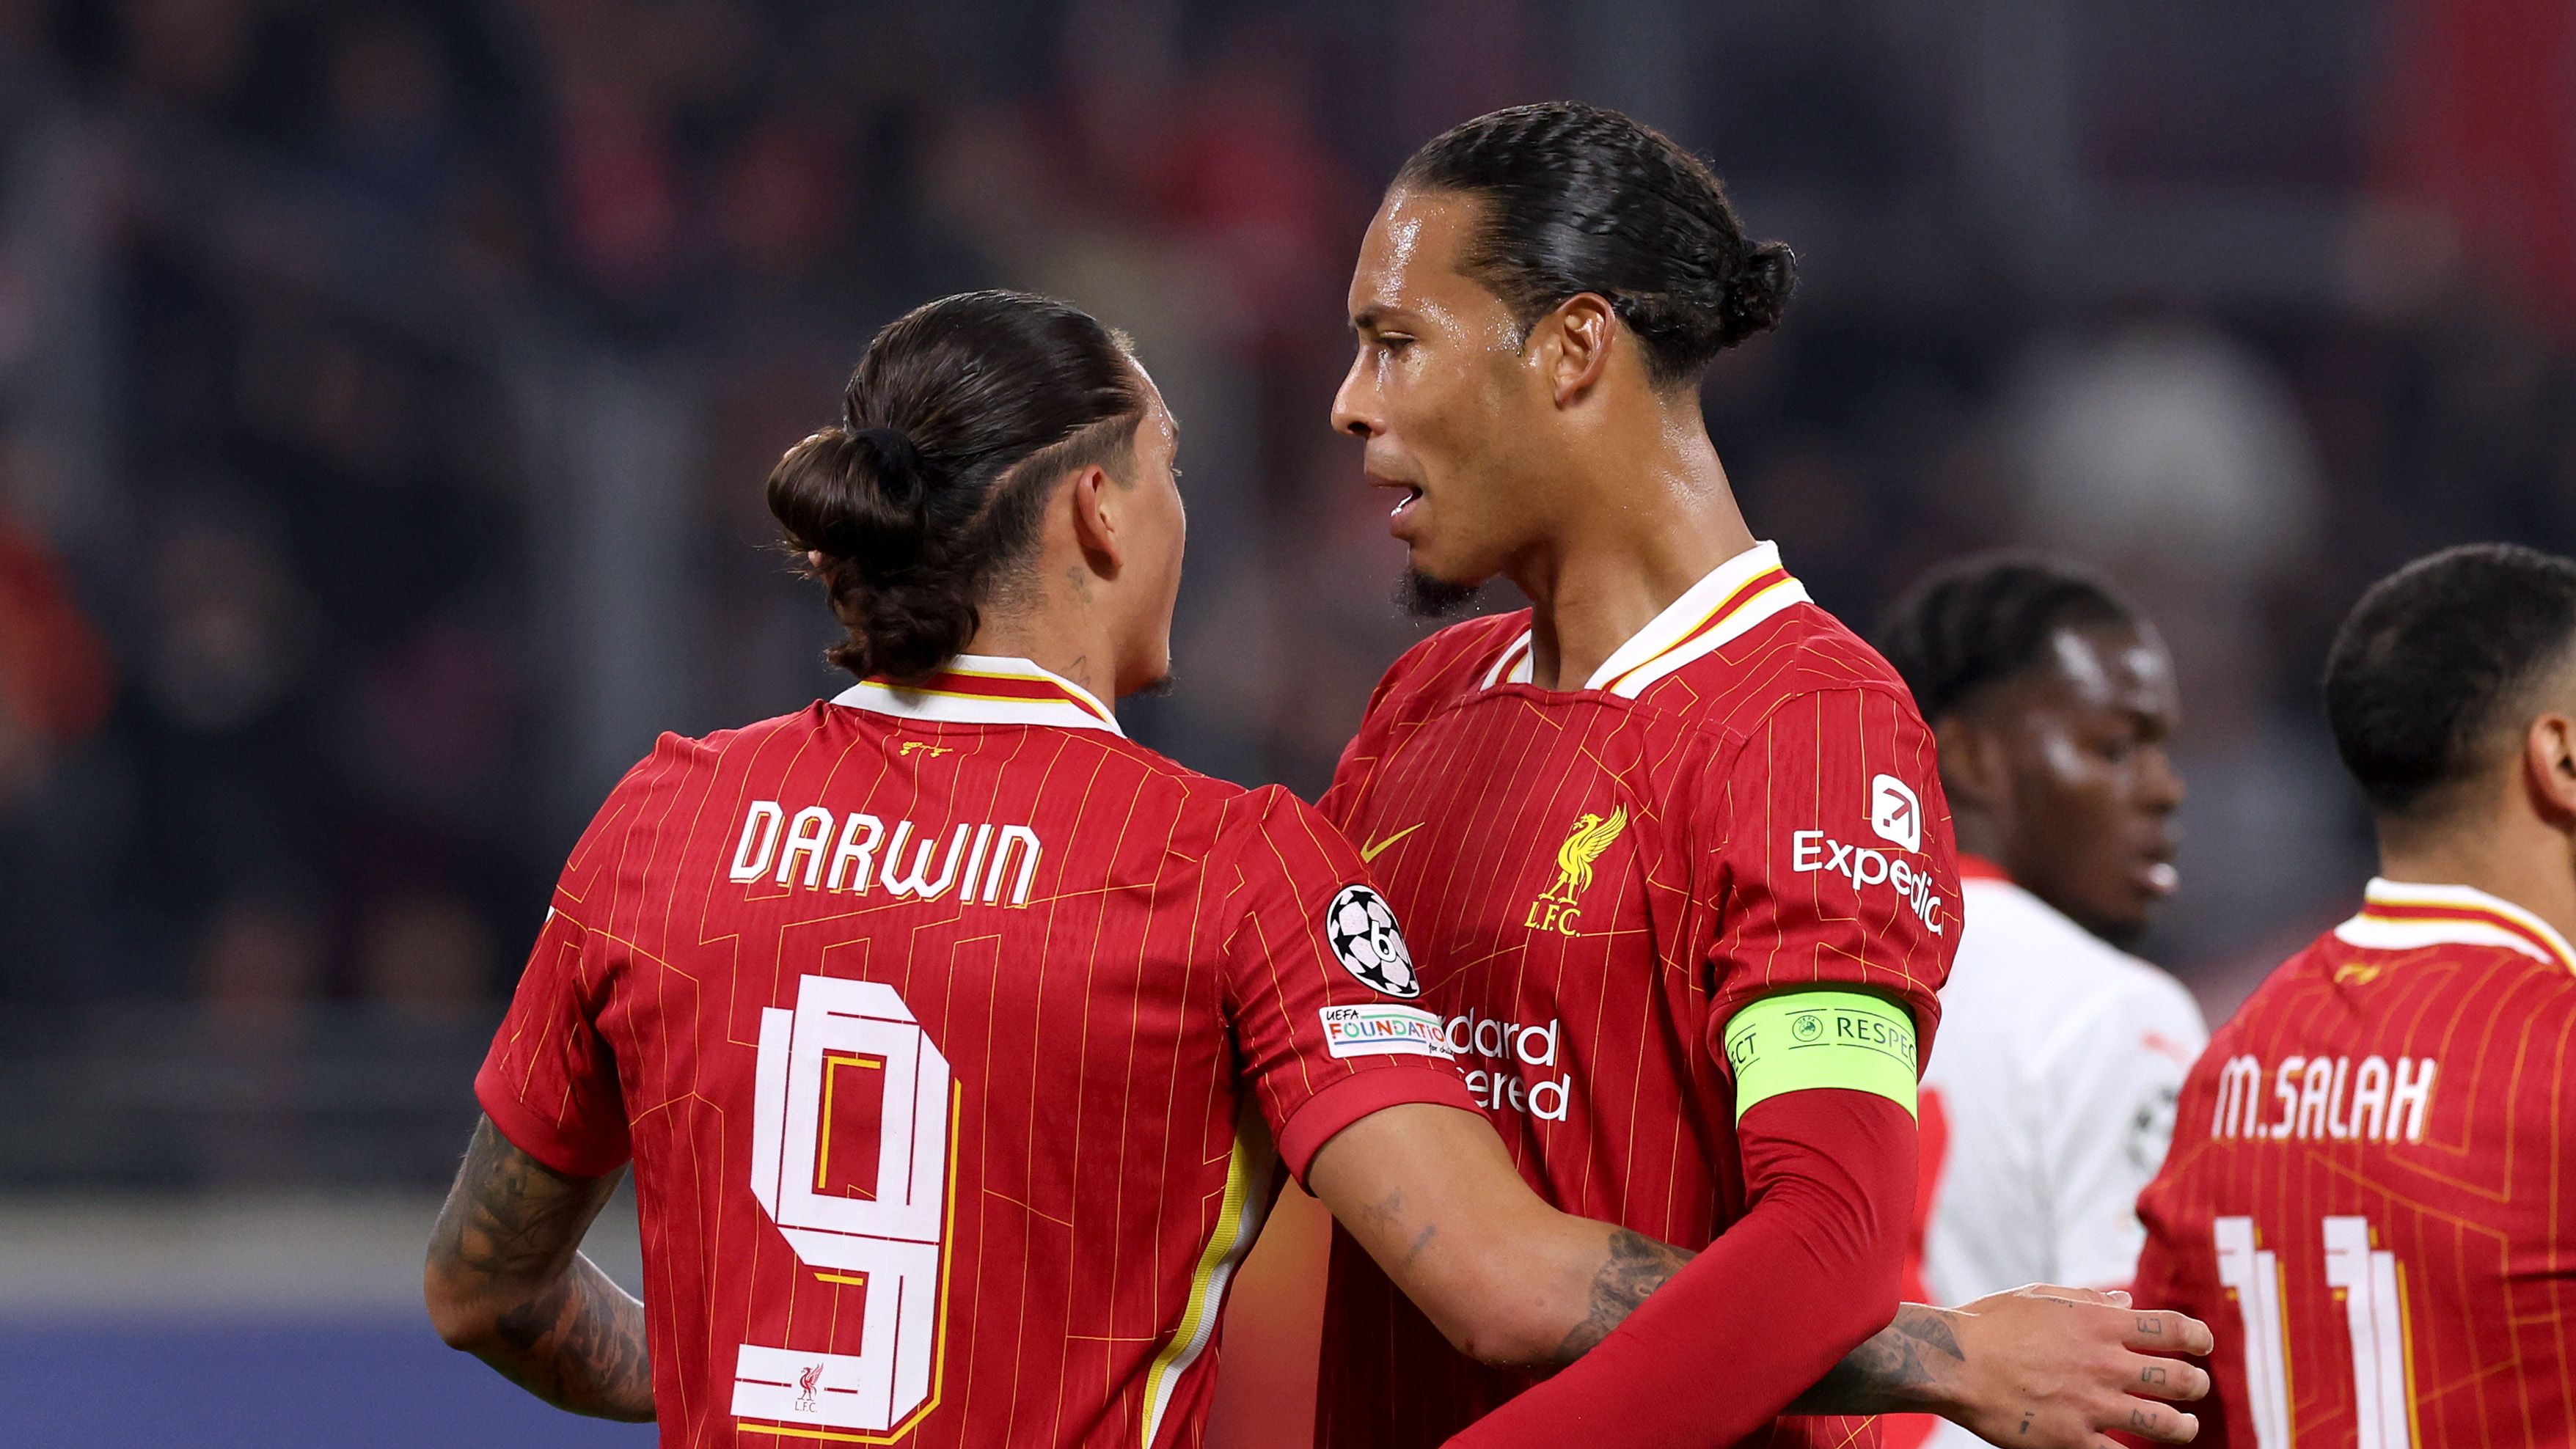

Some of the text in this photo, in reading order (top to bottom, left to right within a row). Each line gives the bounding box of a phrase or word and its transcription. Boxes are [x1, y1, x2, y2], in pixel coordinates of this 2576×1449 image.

[729, 800, 1042, 908] DARWIN
[1371, 920, 1397, 962] 6
[1523, 900, 1581, 937] L.F.C.
[1326, 1009, 1359, 1021] UEFA
[1441, 1006, 1558, 1067] dard
[1798, 1016, 1815, 1024] UEFA
[1456, 1067, 1571, 1122] ered
[2211, 1054, 2438, 1140] M.SALAH
[731, 974, 956, 1437] 9
[2214, 1216, 2416, 1449] 11
[794, 1401, 817, 1413] L.F.C.
